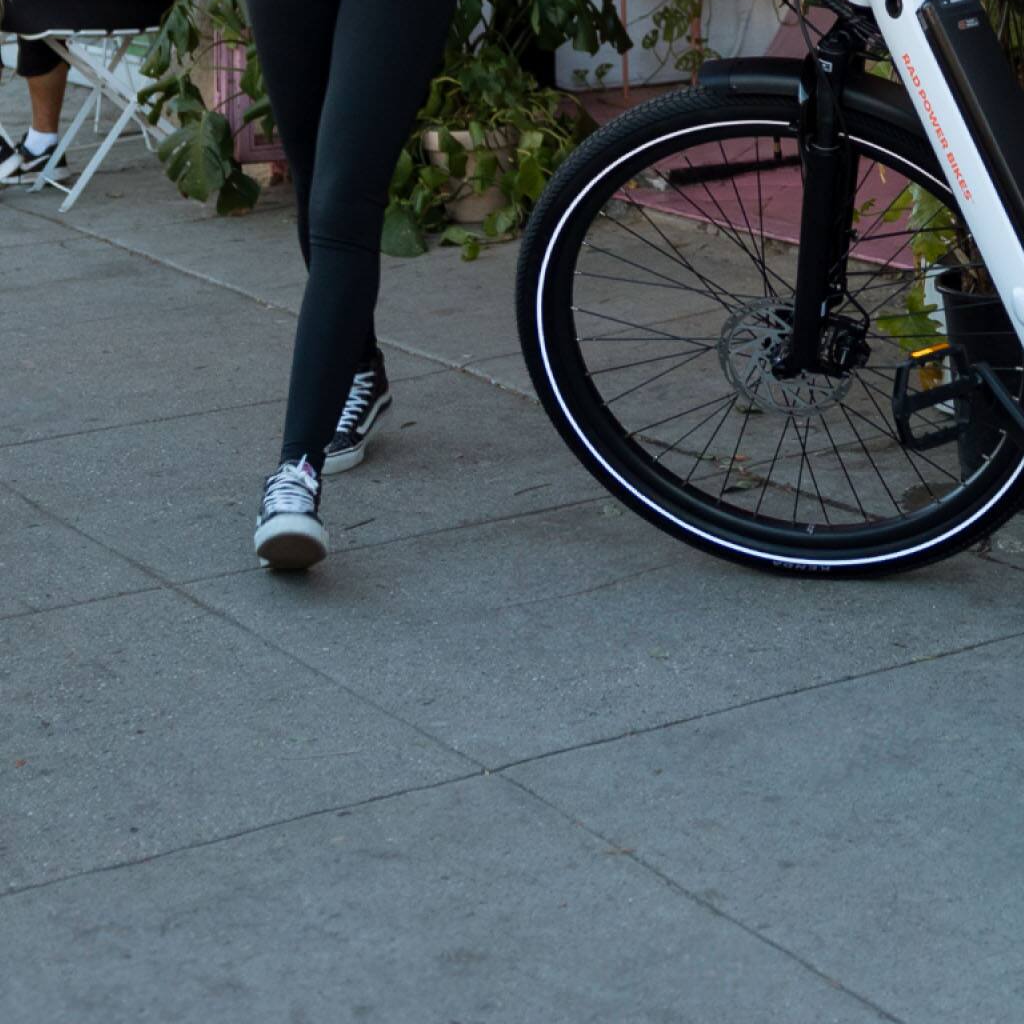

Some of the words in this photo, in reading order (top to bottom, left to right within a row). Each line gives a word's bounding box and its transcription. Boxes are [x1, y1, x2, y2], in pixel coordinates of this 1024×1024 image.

[902, 53, 920, 88] RAD
[918, 88, 949, 149] POWER
[946, 152, 972, 201] BIKES
